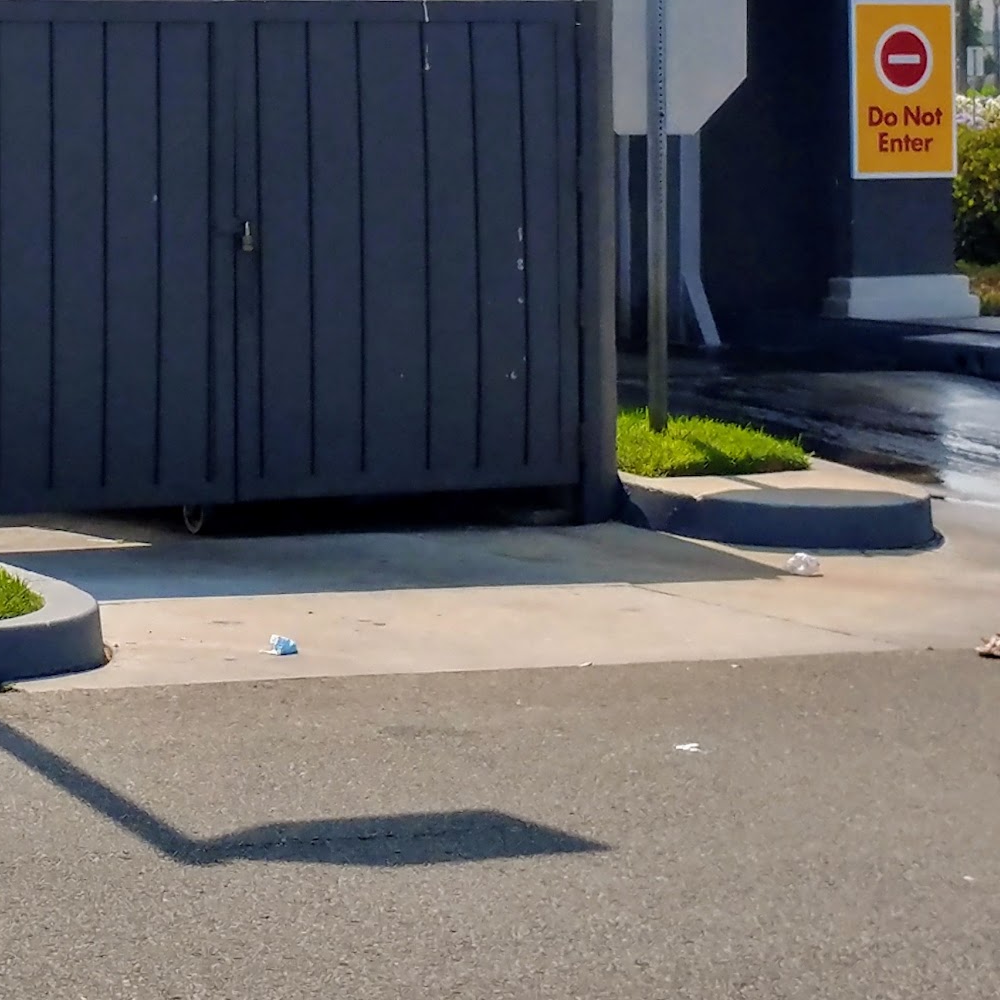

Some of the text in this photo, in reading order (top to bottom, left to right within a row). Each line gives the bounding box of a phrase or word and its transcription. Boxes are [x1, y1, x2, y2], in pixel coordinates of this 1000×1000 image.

[868, 105, 943, 127] Do Not
[878, 131, 934, 153] Enter
